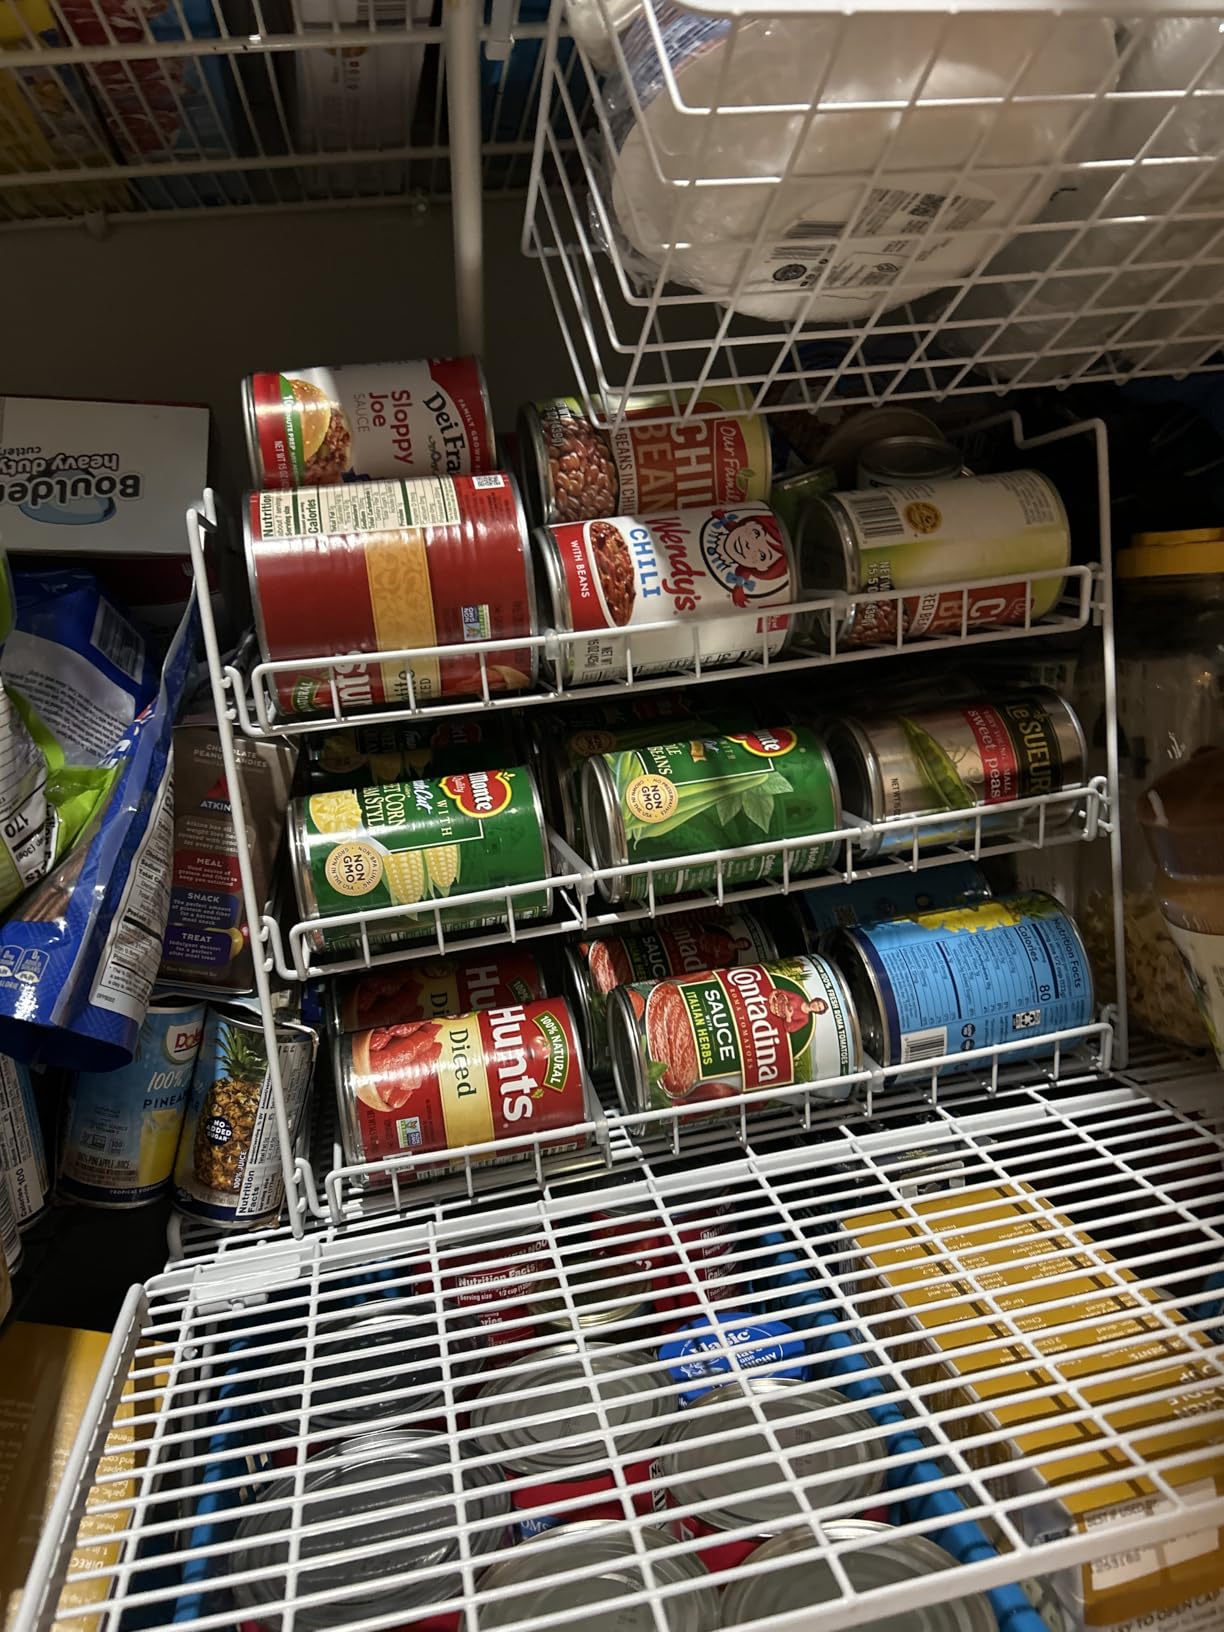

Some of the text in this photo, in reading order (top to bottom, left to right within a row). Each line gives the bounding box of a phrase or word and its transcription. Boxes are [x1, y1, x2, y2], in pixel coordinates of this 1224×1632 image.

[353, 392, 370, 434] SAUCE
[369, 391, 389, 428] Joe
[390, 389, 415, 466] Sloppy
[422, 390, 455, 432] Dei
[287, 432, 297, 451] PREP
[614, 433, 632, 471] BEANS
[719, 426, 737, 457] Our
[51, 452, 120, 472] heavy
[621, 472, 633, 486] IN
[632, 421, 676, 516] BEAN
[670, 419, 713, 511] CHIL
[261, 494, 275, 539] Nutrition
[306, 498, 320, 535] Calories
[570, 539, 591, 599] WITH BEANS
[630, 528, 661, 598] CHILI
[645, 516, 706, 613] Wendy's
[967, 709, 1002, 799] sweet peas
[1017, 719, 1052, 792] SUEUR
[200, 800, 233, 812] ATKIN
[384, 792, 407, 829] CORN
[468, 773, 495, 812] Monte
[640, 785, 655, 811] GMO
[650, 784, 664, 809] NON
[4, 812, 30, 839] 170
[436, 799, 454, 838] WITH
[196, 857, 224, 868] MEAL
[332, 847, 350, 867] GROWN
[343, 855, 355, 884] GMO
[353, 854, 366, 882] NON
[187, 891, 221, 904] SNACK
[361, 869, 379, 889] LINING
[181, 932, 213, 944] TREAT
[642, 935, 667, 978] SAUC
[1053, 918, 1083, 990] Nutrition Facts
[1018, 925, 1052, 1002] Calories 80
[685, 990, 704, 1027] ITALIAN
[696, 1028, 713, 1067] HERBS
[704, 989, 735, 1062] SAUCE
[705, 1014, 714, 1032] WITH
[726, 968, 779, 1083] Contadina
[730, 987, 755, 1071] ROMA TOMATOES
[819, 972, 849, 1066] 100% FRESH ROMA TOMATOES
[449, 1028, 477, 1099] Diced
[540, 1015, 567, 1084] 100% NATURAL
[206, 1124, 232, 1138] ADDED
[206, 1132, 229, 1142] SUGAR
[213, 1118, 227, 1128] NO
[15, 1167, 26, 1185] 100
[236, 1150, 248, 1171] JUICE
[238, 1169, 256, 1214] Nutrition
[248, 1186, 261, 1214] Facts
